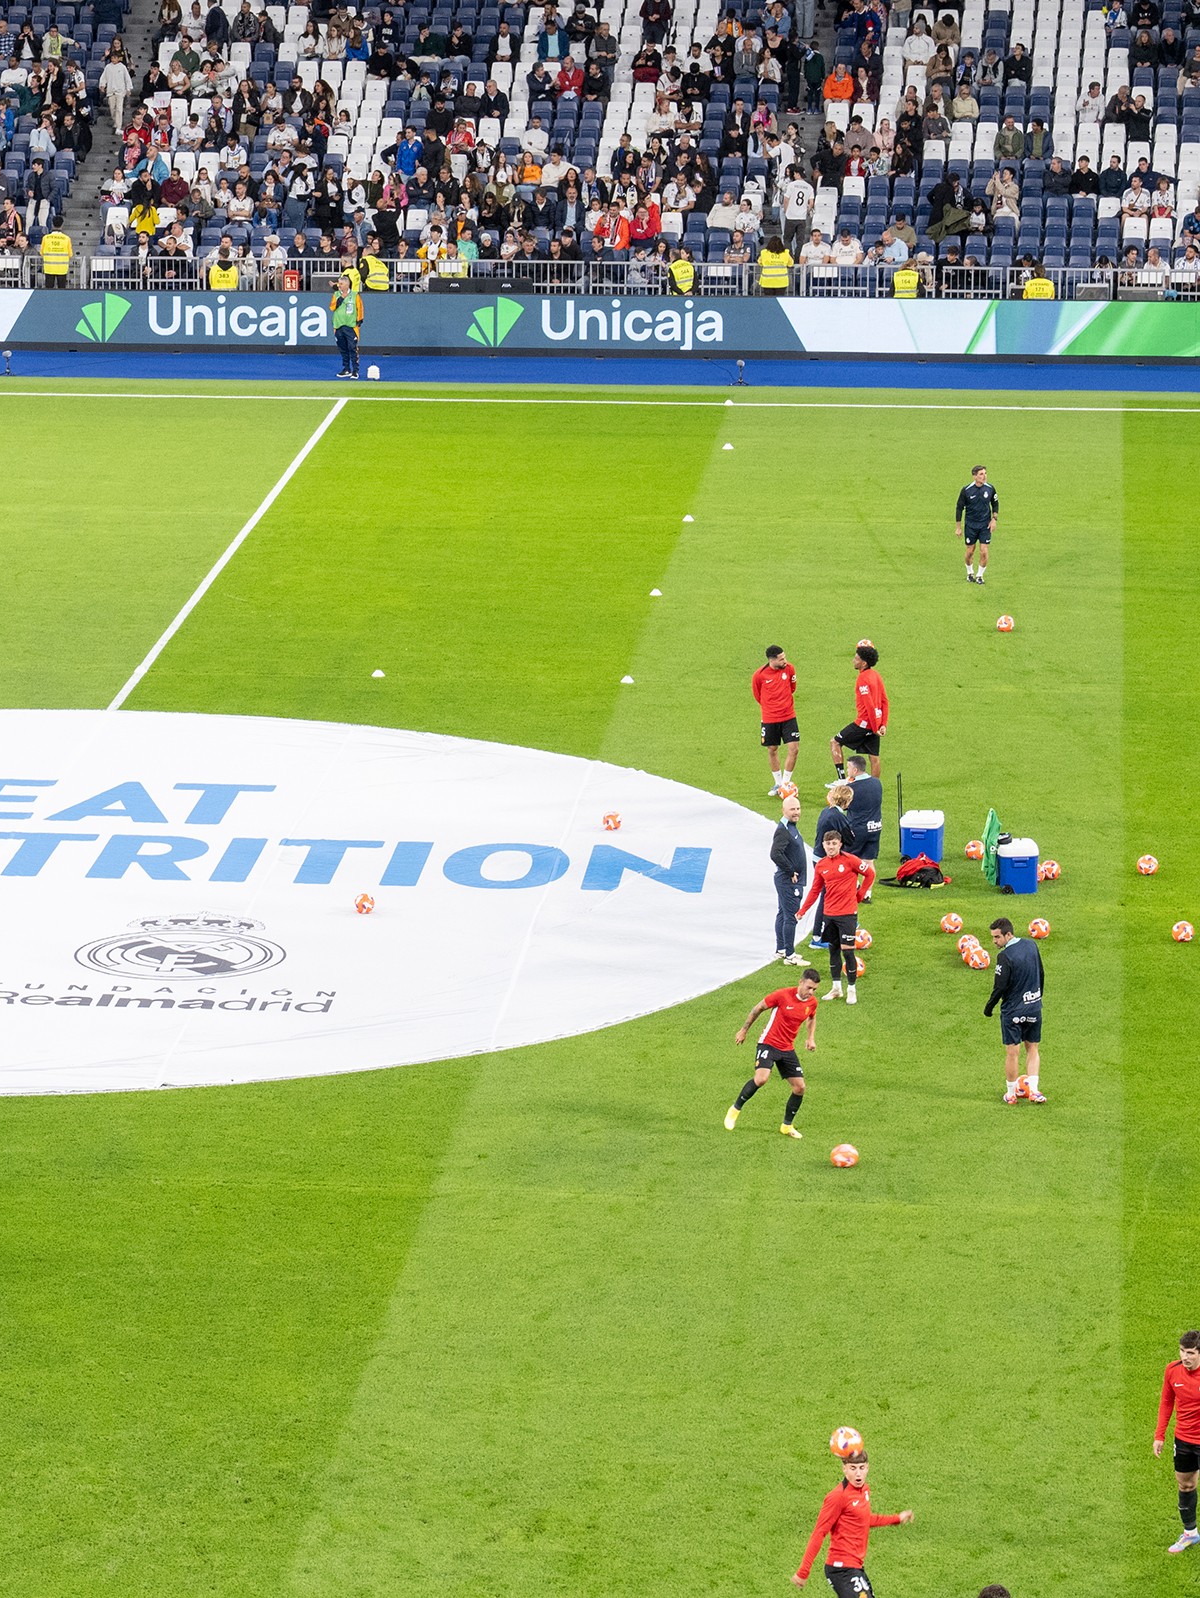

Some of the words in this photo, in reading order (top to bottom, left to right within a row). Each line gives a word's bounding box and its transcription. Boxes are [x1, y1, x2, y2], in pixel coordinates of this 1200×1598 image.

[796, 191, 804, 206] 8
[148, 294, 327, 345] Unicaja
[542, 299, 722, 350] Unicaja
